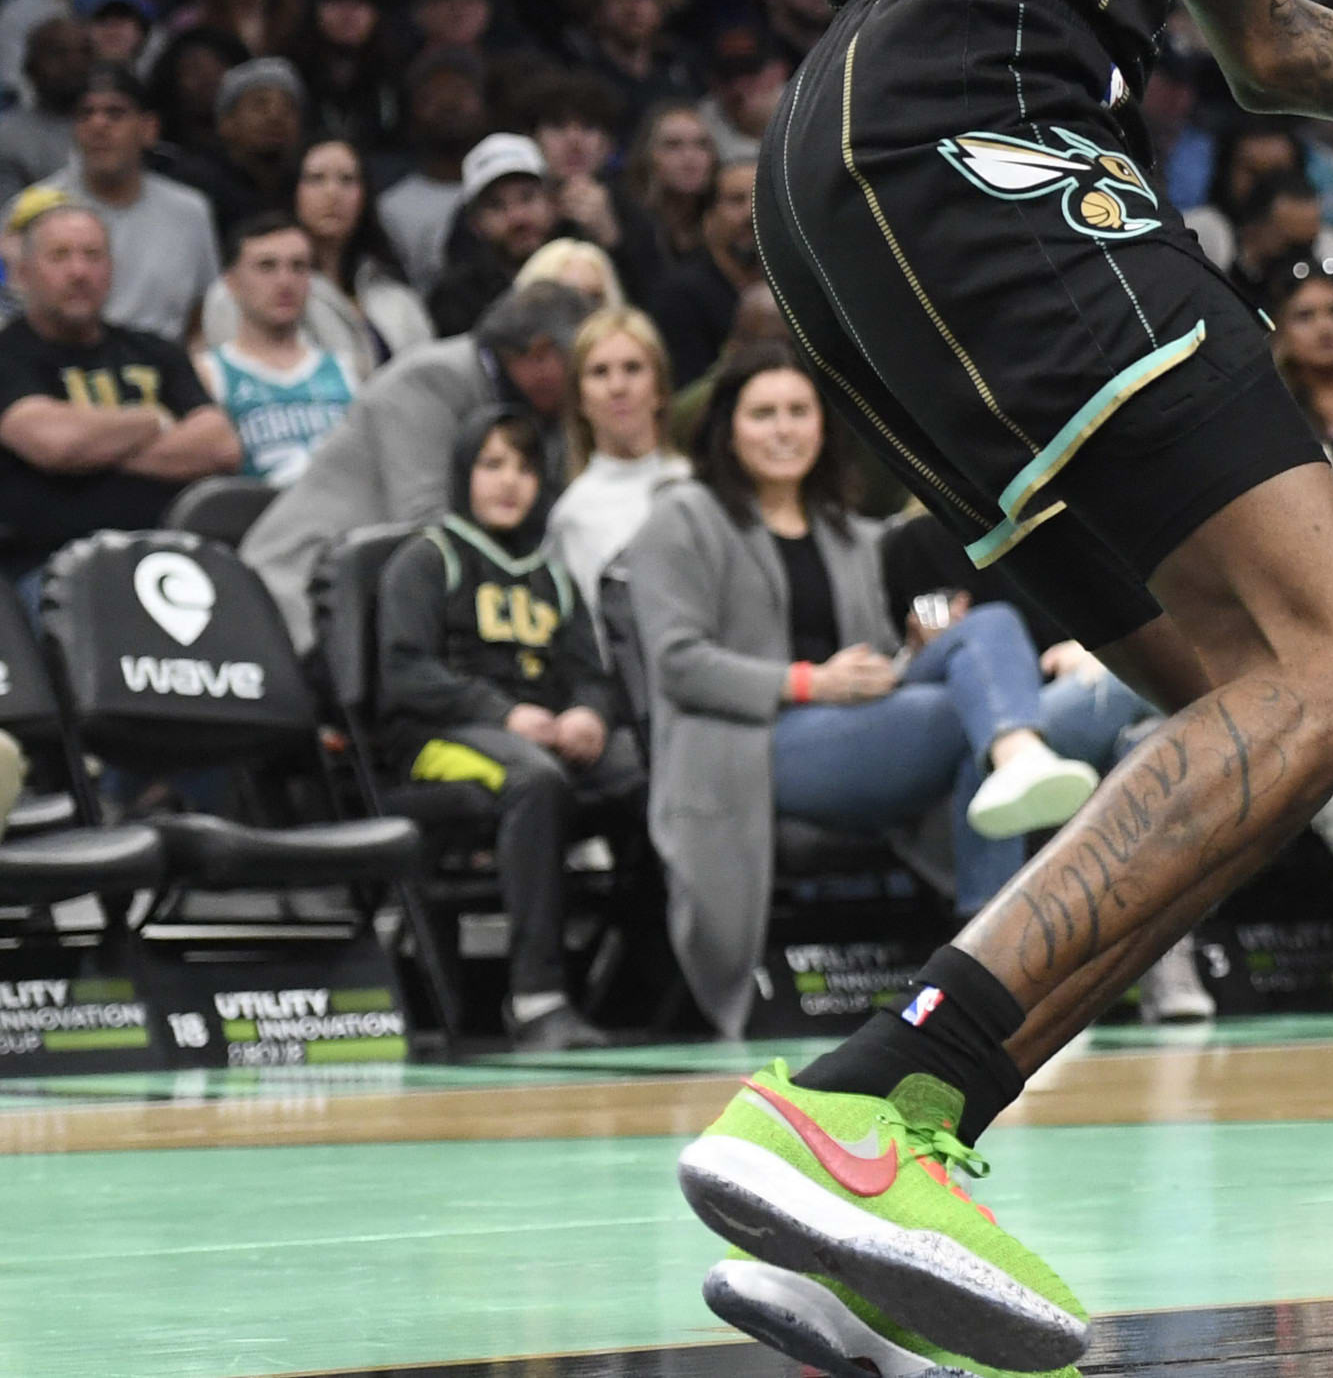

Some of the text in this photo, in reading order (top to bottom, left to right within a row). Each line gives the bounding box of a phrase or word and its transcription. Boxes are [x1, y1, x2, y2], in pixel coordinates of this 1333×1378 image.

[120, 654, 265, 699] wave
[0, 979, 68, 1009] LITY
[214, 988, 329, 1020] UTILITY
[257, 1011, 405, 1041] INNOVATION
